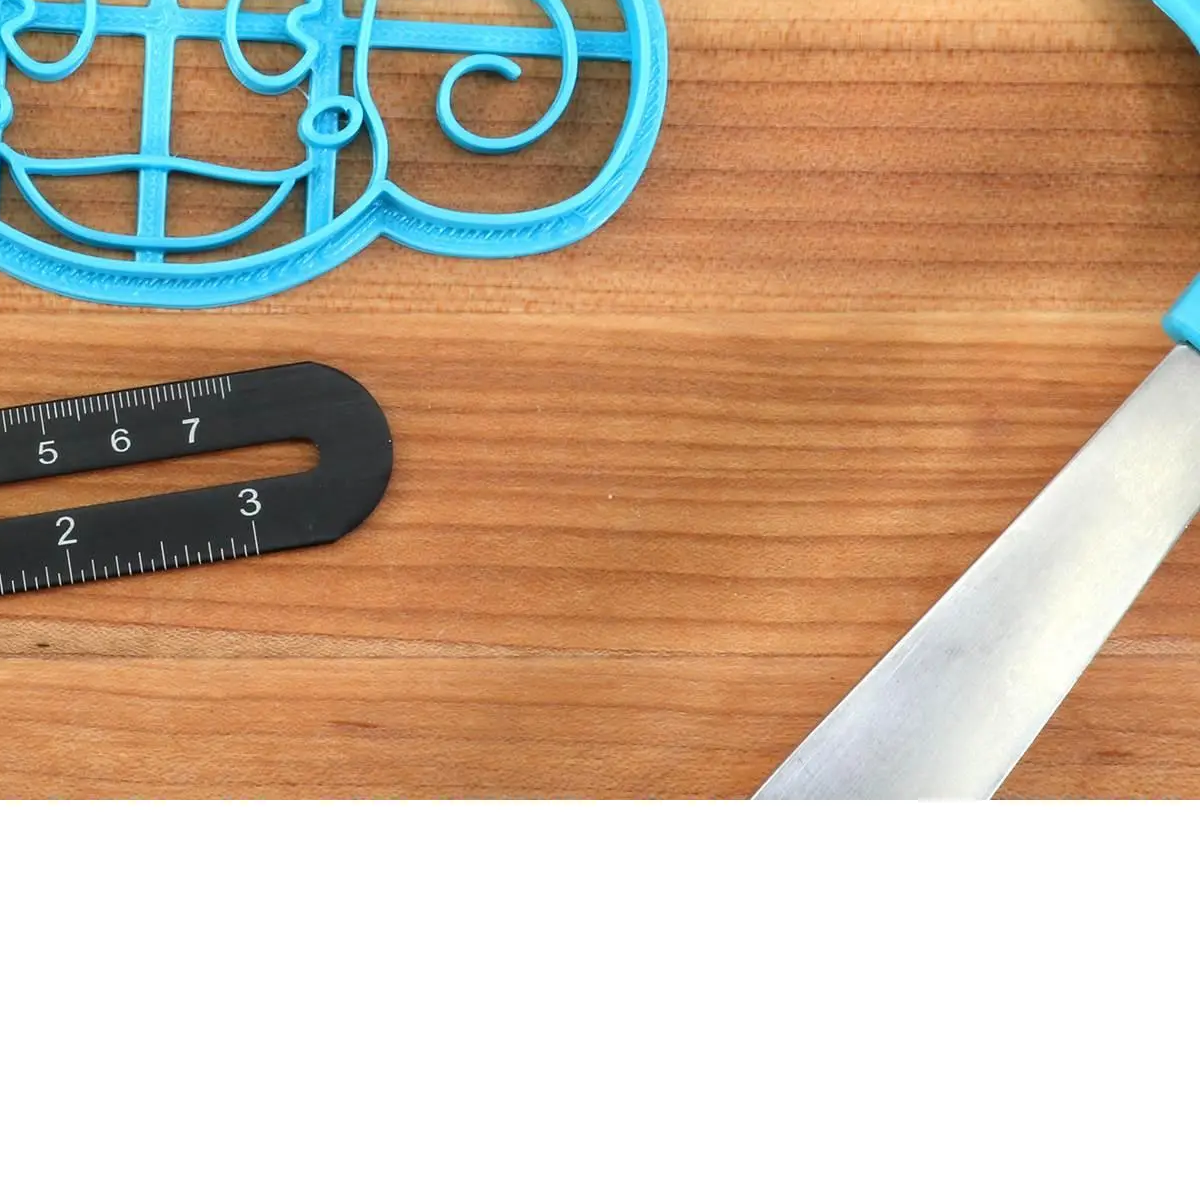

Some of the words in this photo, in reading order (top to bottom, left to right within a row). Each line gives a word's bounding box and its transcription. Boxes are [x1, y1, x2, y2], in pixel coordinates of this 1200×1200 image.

[39, 440, 58, 464] 5
[111, 429, 131, 452] 6
[182, 418, 200, 443] 7
[56, 516, 77, 545] 2
[238, 488, 261, 516] 3
